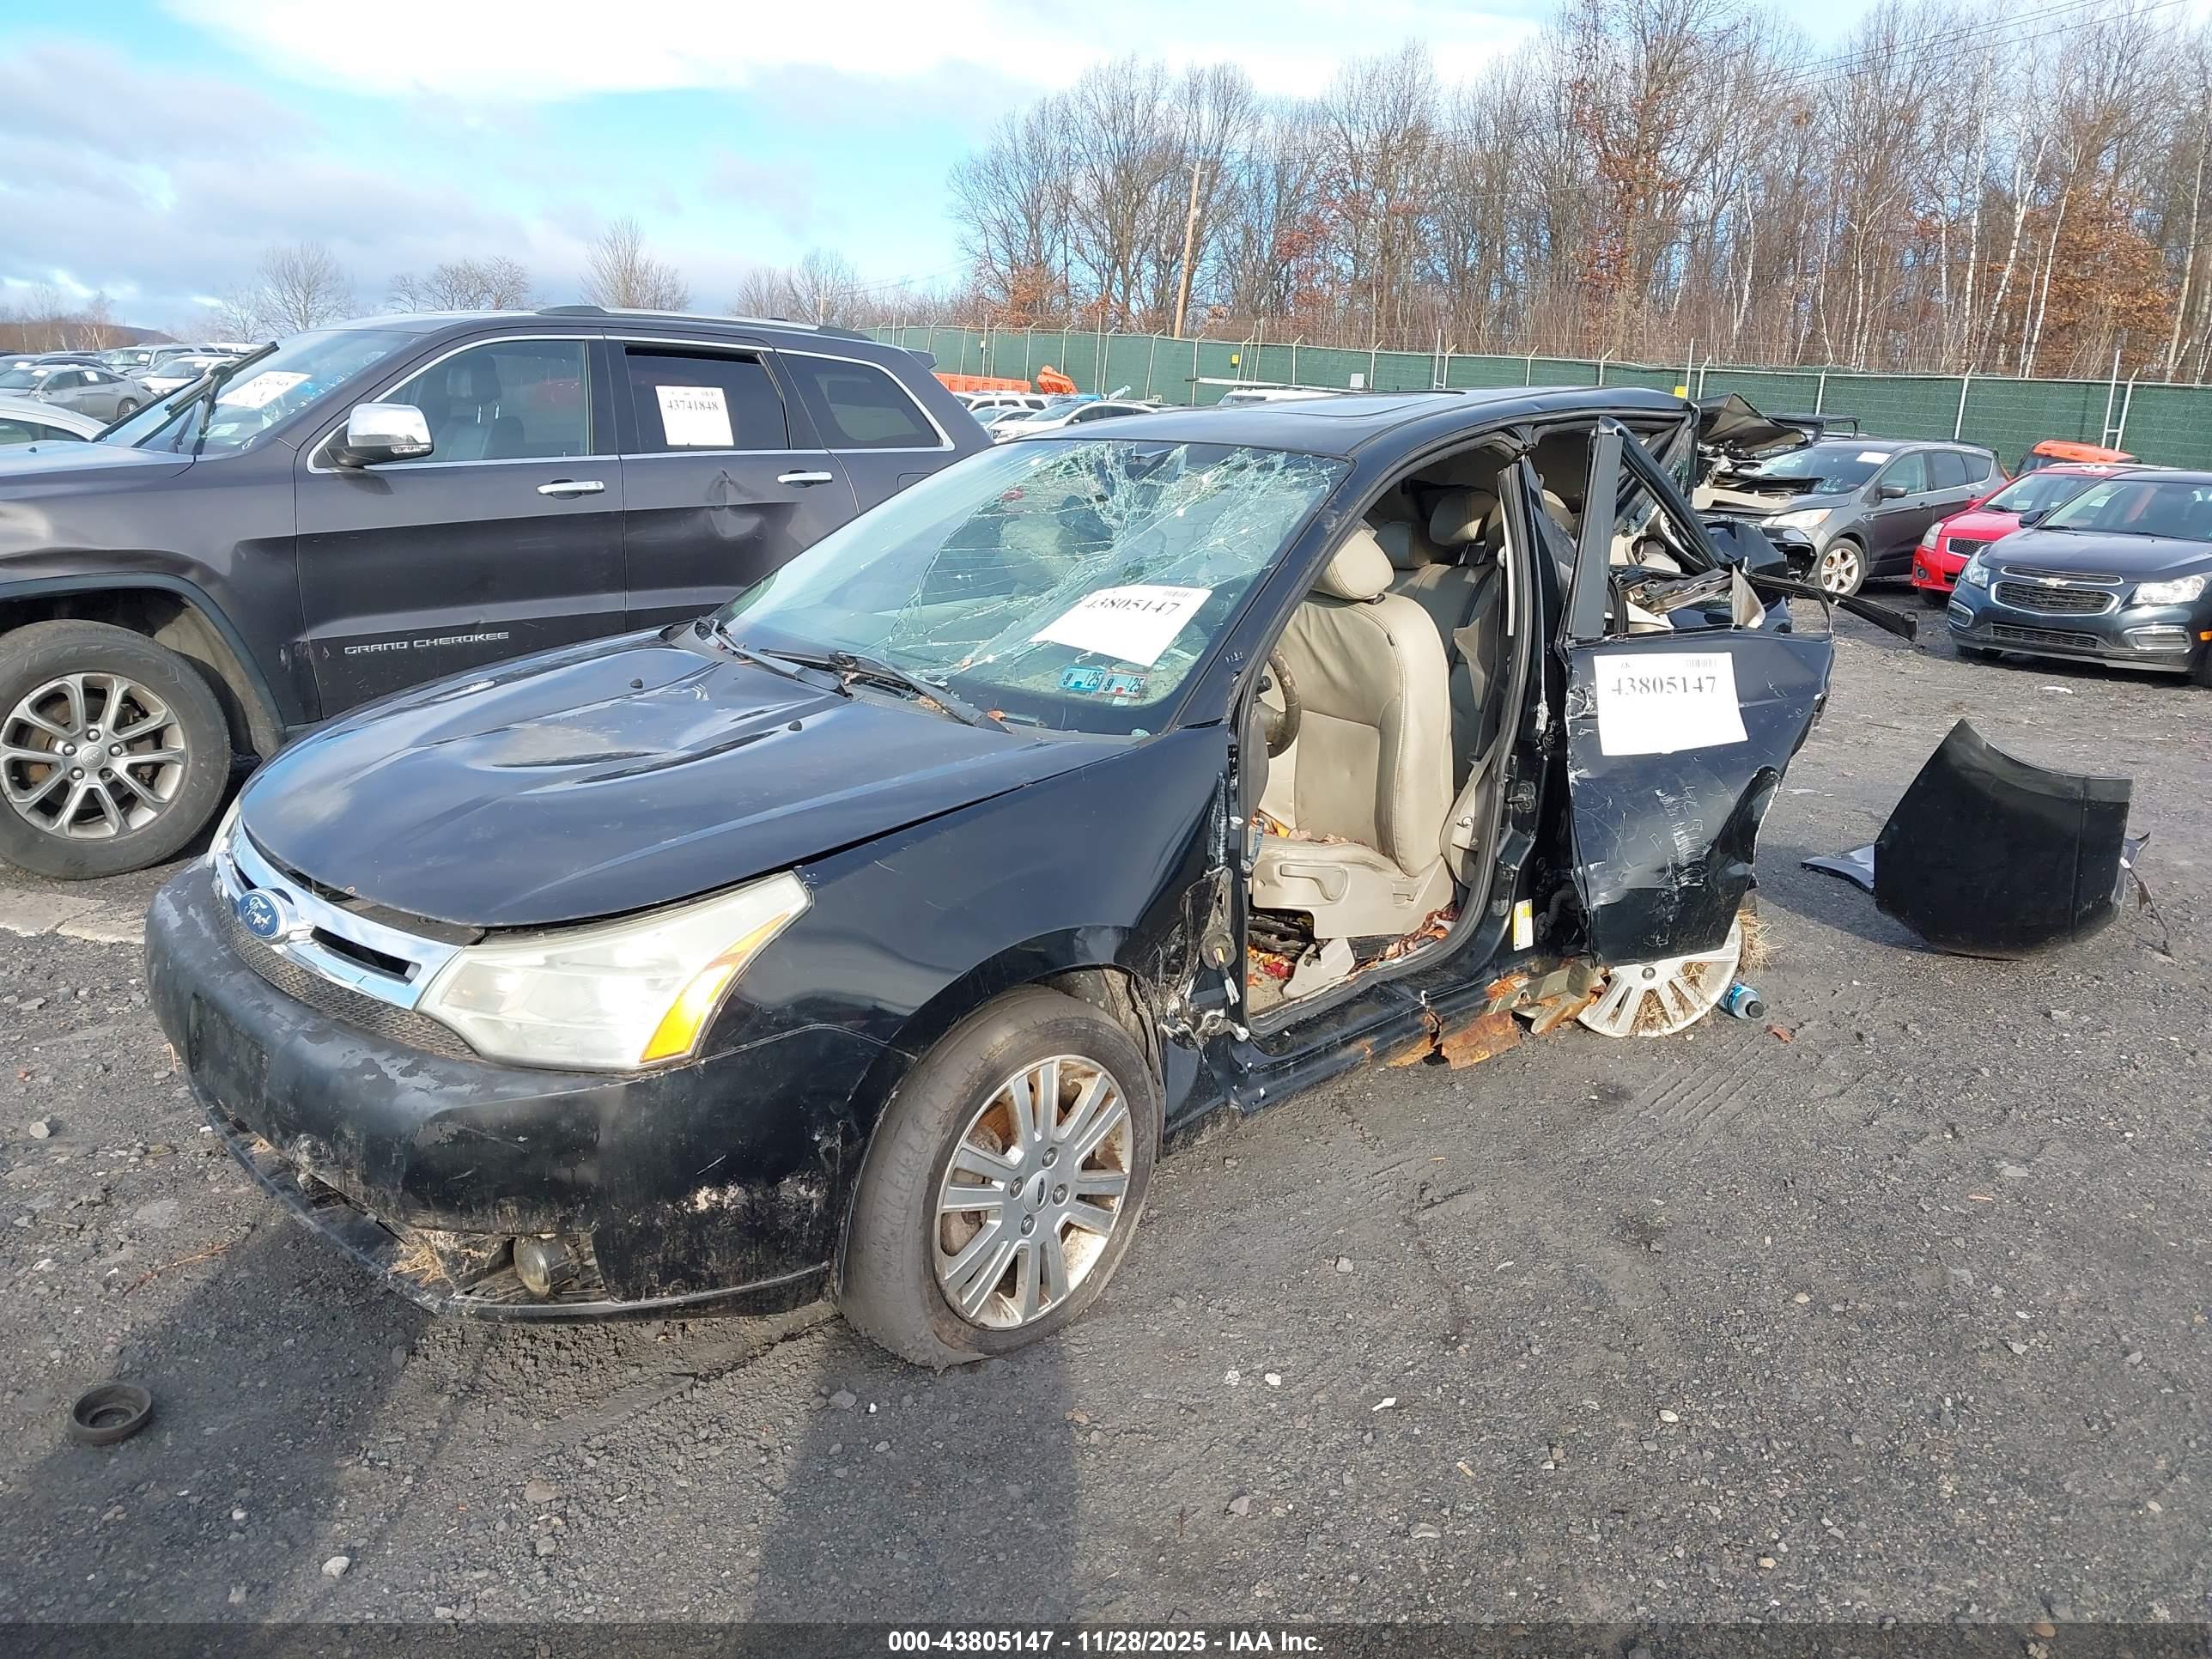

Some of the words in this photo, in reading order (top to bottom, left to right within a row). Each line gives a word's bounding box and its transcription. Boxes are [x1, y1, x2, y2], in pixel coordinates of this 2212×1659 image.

[667, 399, 719, 410] 43741848
[1085, 598, 1182, 616] 43805147
[344, 641, 409, 654] GRAND
[413, 631, 509, 648] CHEROKEE
[1612, 676, 1717, 696] 43805147
